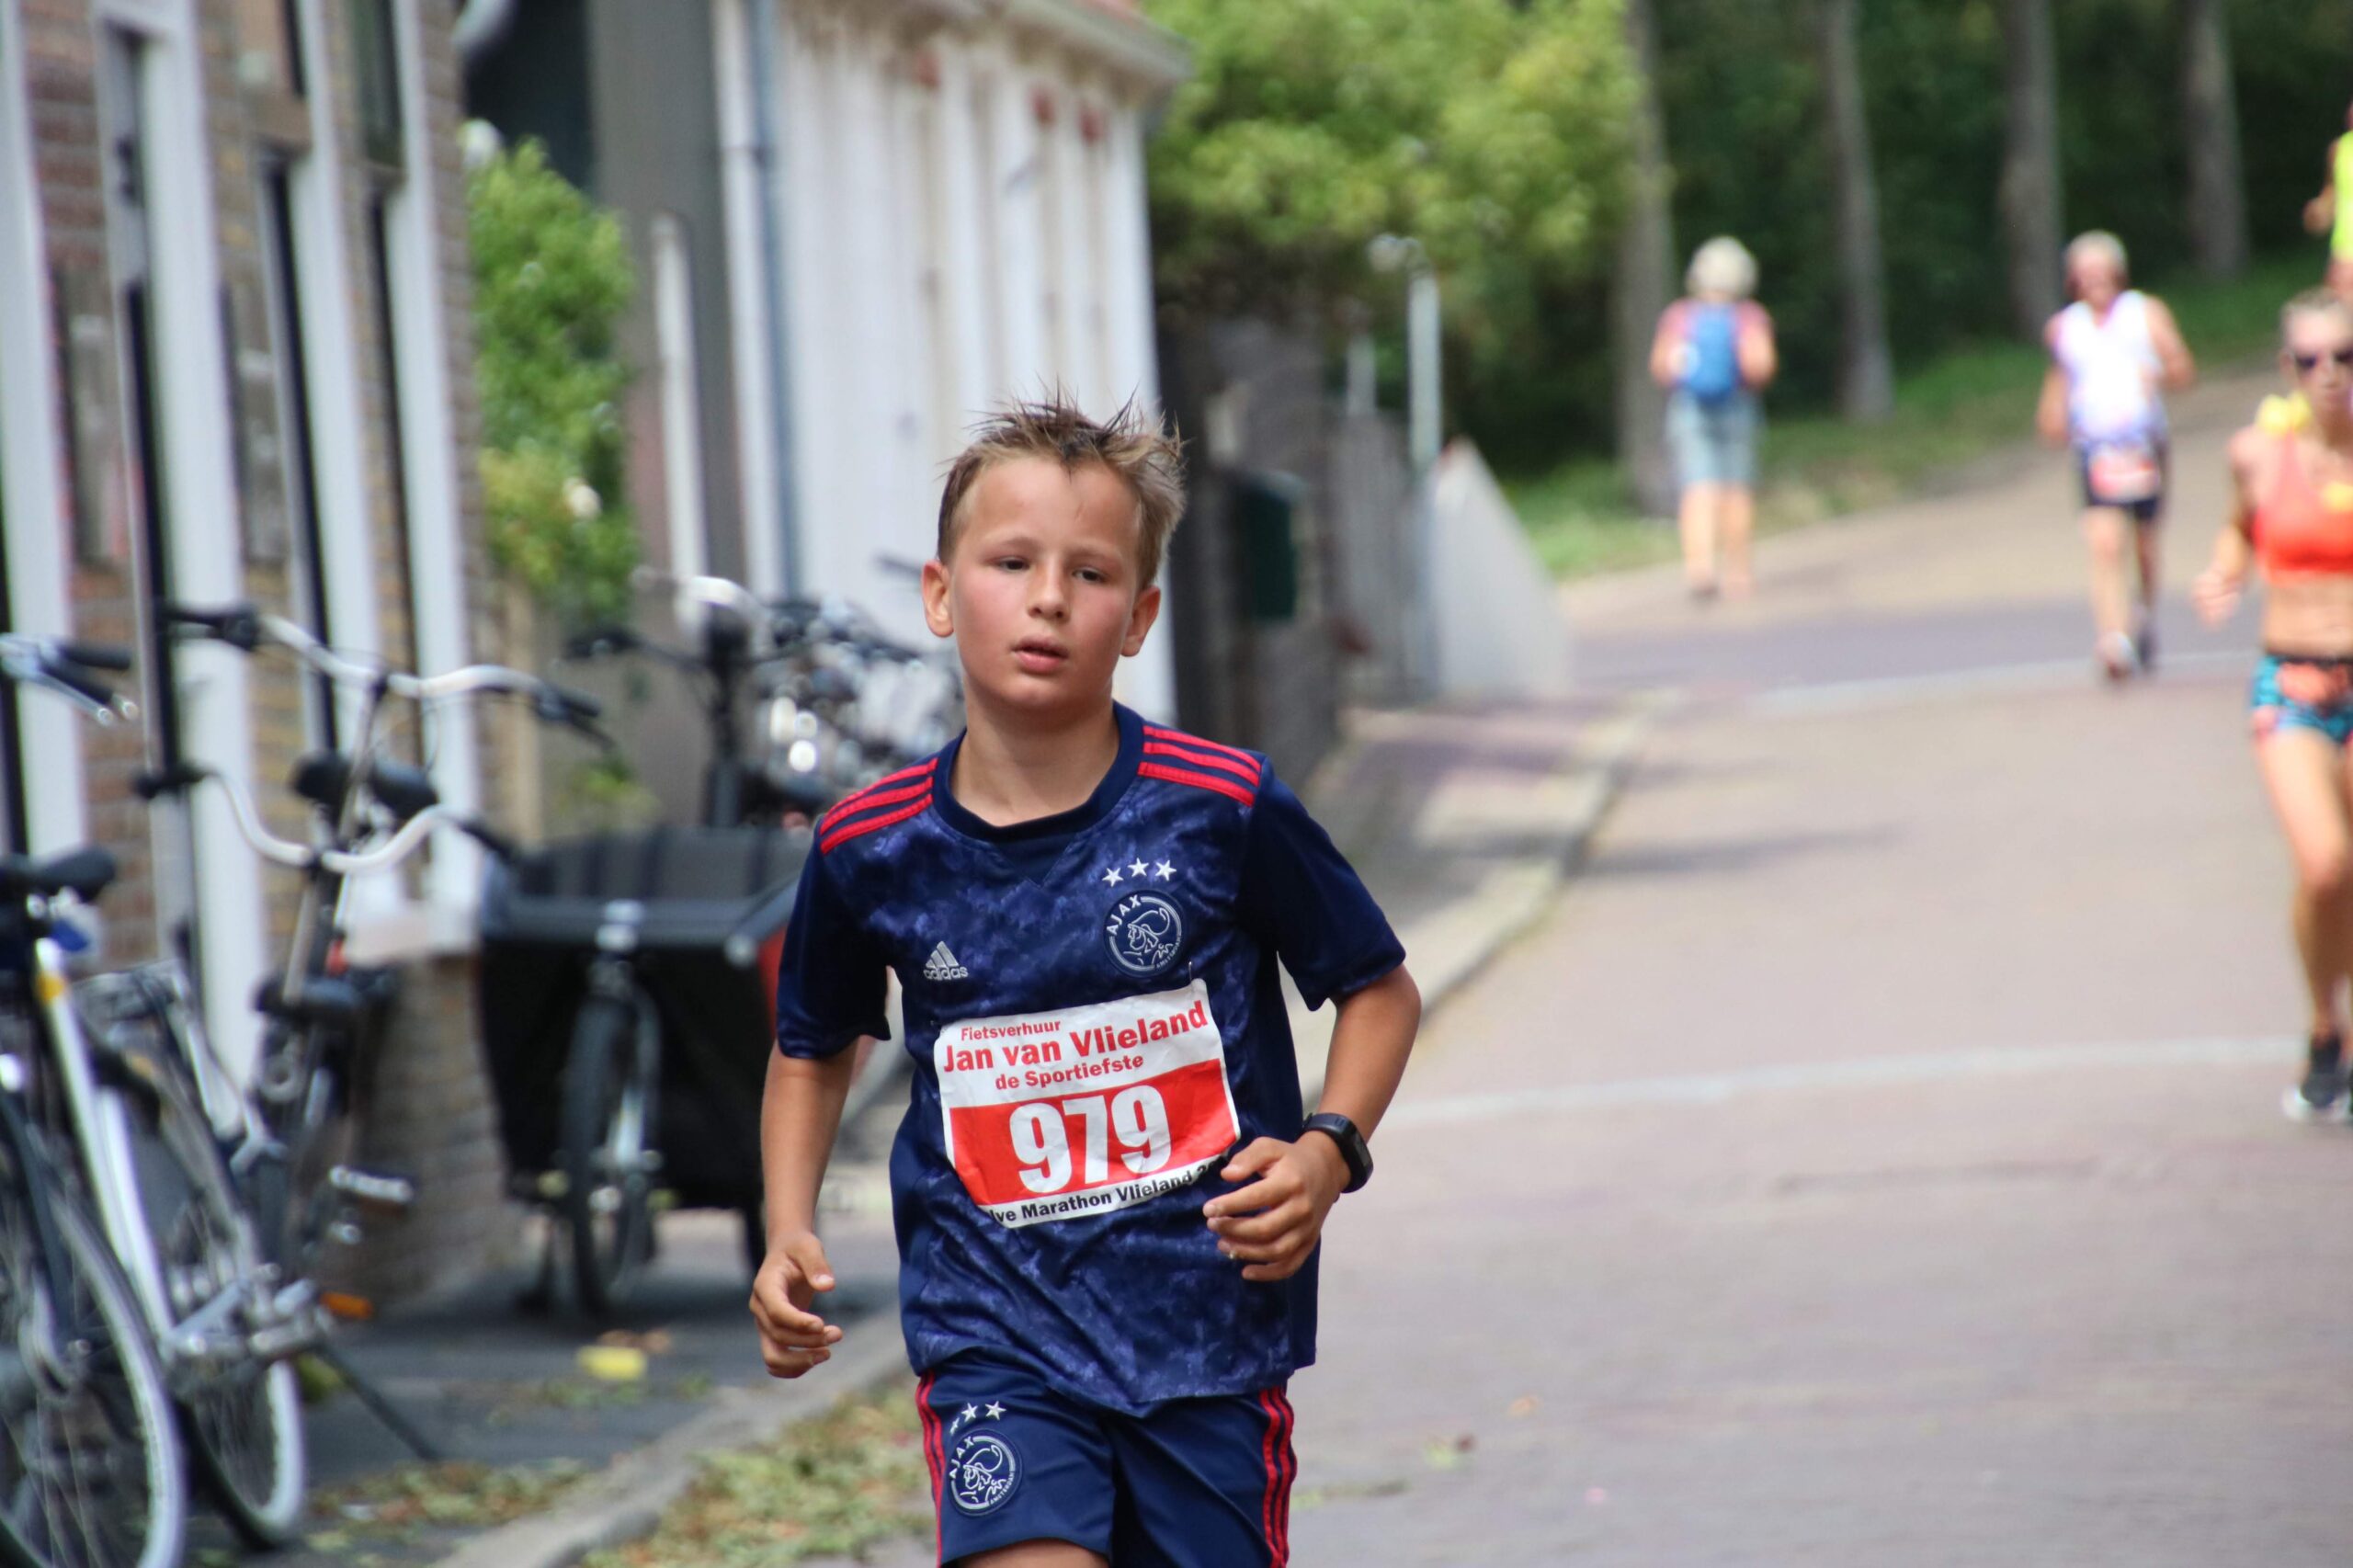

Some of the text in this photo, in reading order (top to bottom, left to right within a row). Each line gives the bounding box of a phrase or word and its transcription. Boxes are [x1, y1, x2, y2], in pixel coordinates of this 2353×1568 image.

[1107, 894, 1142, 936] AJAX
[923, 965, 969, 982] adidas
[944, 999, 1209, 1073] Jan van Vlieland
[961, 1019, 1062, 1041] Fietsverhuur
[995, 1055, 1144, 1090] de Sportiefste
[1008, 1085, 1172, 1194] 979
[989, 1209, 1017, 1222] lve
[1021, 1192, 1112, 1219] Marathon
[1115, 1170, 1193, 1202] Vlieland
[949, 1436, 975, 1480] AJAX
